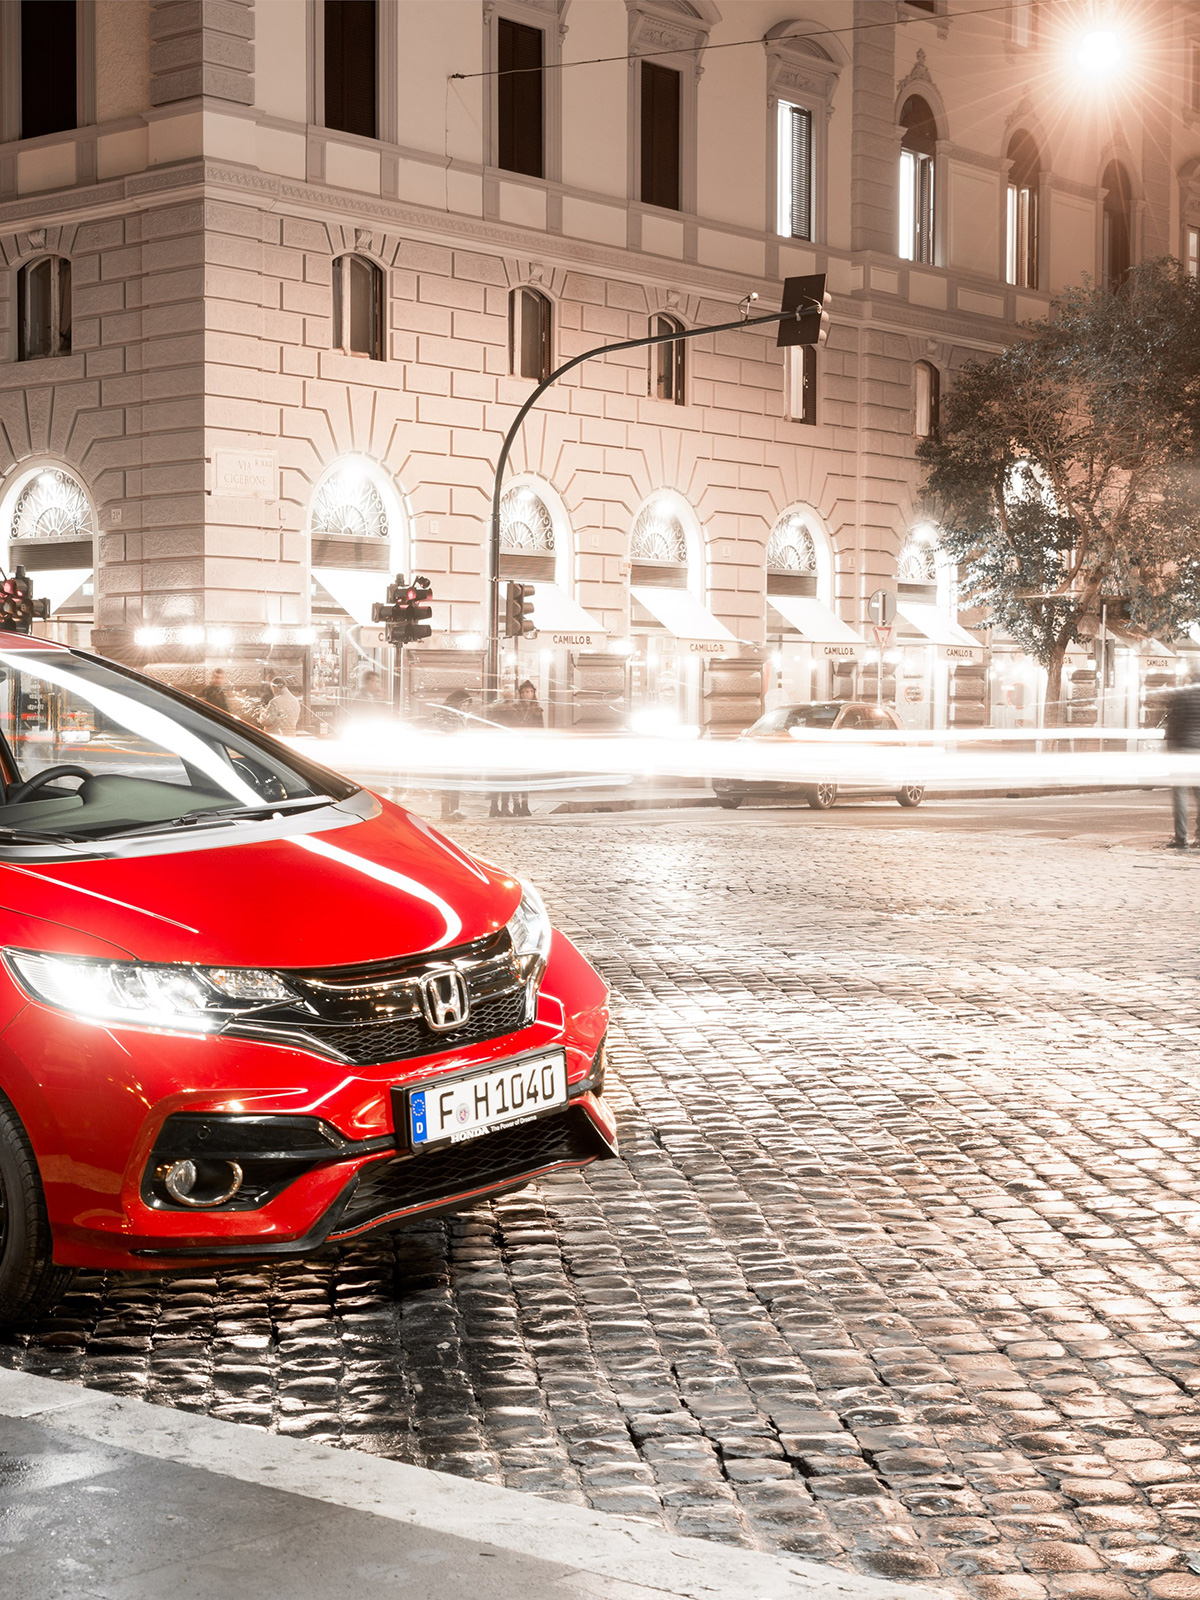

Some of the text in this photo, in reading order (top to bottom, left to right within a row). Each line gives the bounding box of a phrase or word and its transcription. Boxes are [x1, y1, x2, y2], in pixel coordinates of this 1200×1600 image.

[237, 460, 252, 471] VIA
[223, 473, 266, 486] CICERONE
[552, 635, 593, 645] CAMILLO B.
[824, 646, 849, 655] CAMILLO
[946, 649, 969, 658] CAMILLO
[1147, 659, 1164, 667] CAMILLO
[439, 1091, 454, 1130] F
[416, 1122, 424, 1134] D
[450, 1126, 490, 1144] HONDA
[490, 1124, 499, 1132] The
[500, 1120, 515, 1129] Power
[520, 1115, 538, 1125] Dreams
